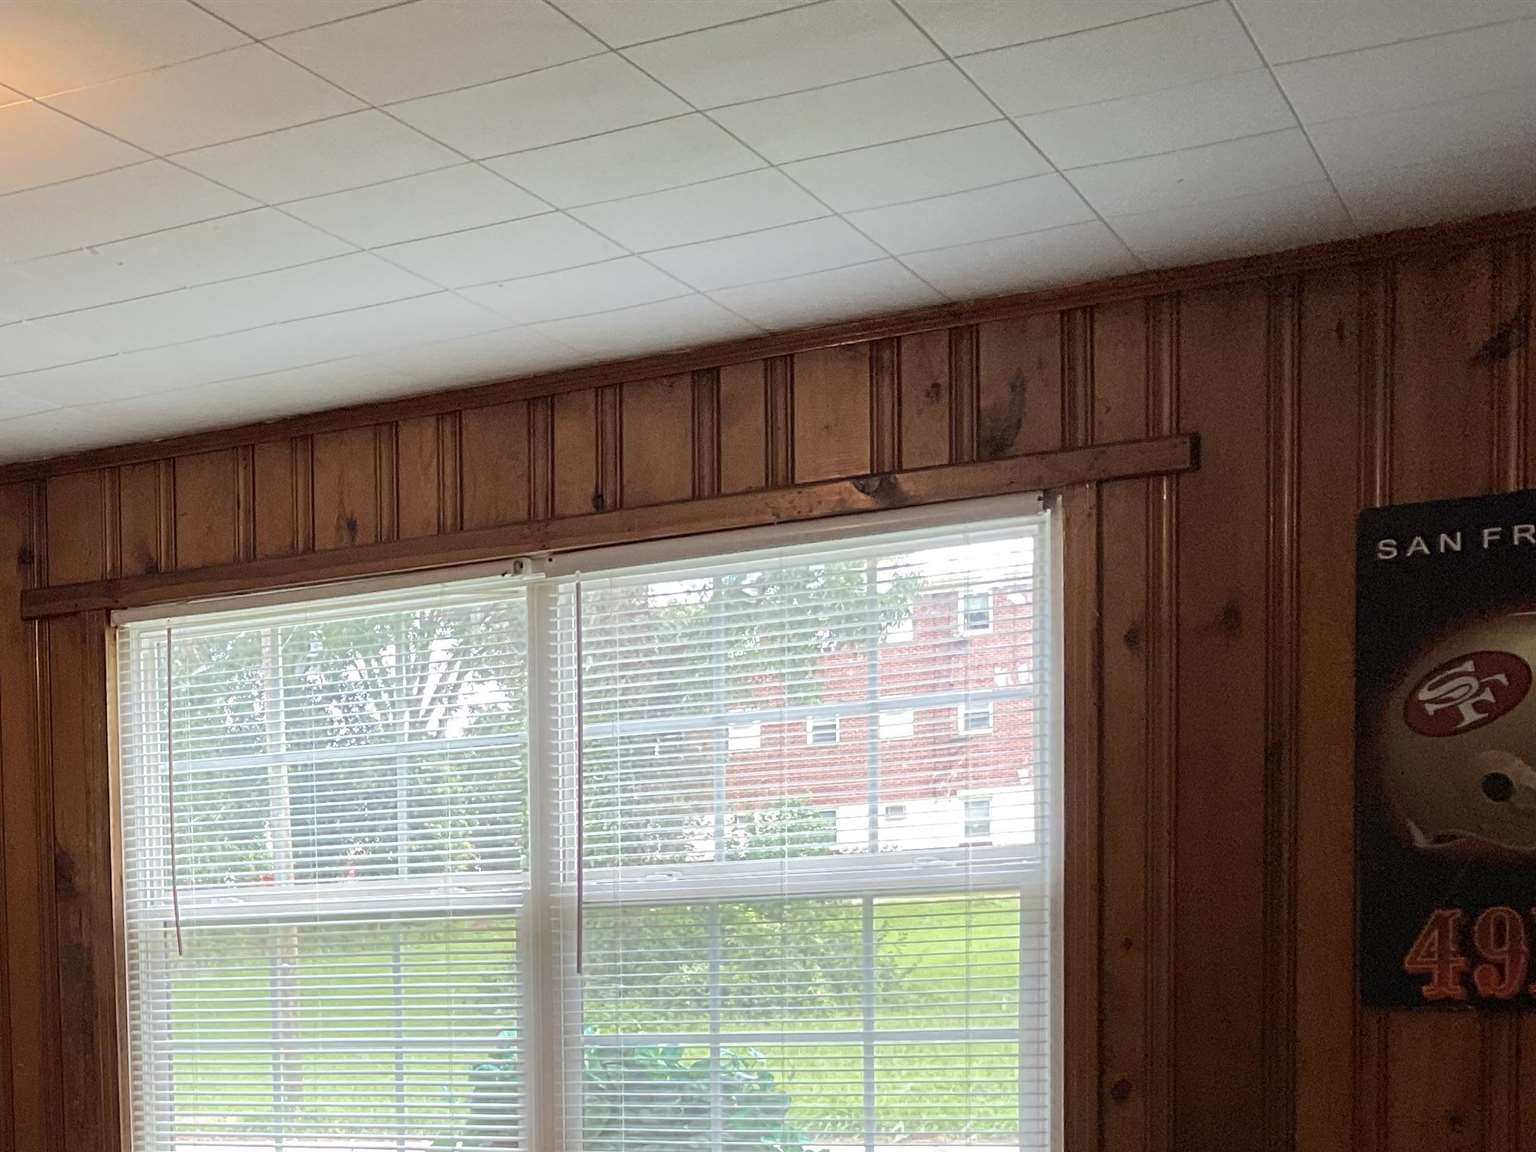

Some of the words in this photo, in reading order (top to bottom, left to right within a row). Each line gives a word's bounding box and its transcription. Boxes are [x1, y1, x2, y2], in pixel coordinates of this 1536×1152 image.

[1377, 532, 1462, 560] SAN
[1482, 524, 1536, 549] FR
[1403, 906, 1536, 1000] 49
